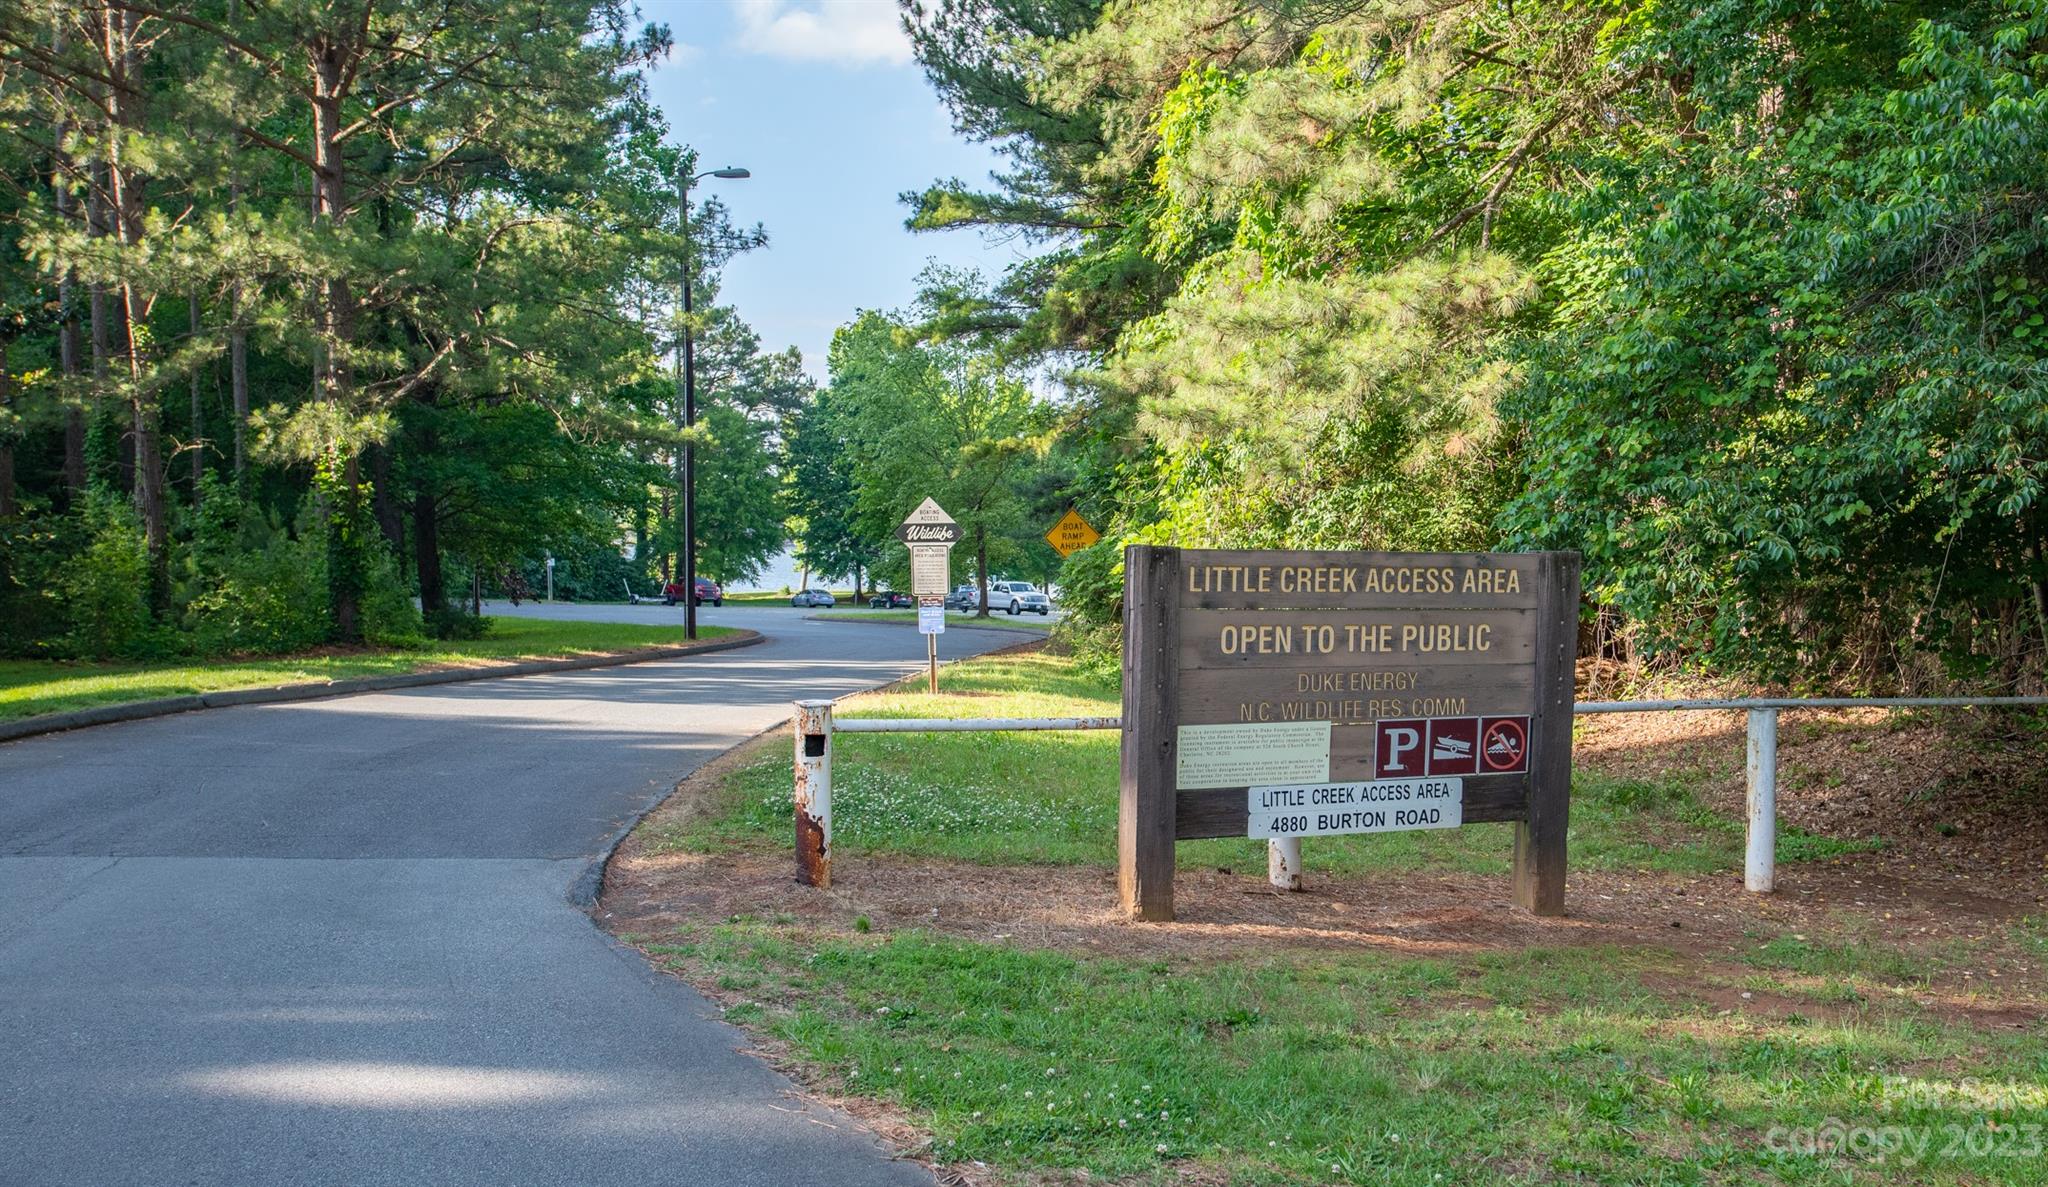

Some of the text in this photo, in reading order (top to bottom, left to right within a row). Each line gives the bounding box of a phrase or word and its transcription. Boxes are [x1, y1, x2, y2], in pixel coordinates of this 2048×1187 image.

[906, 525, 953, 540] Wildlife
[1189, 567, 1520, 593] LITTLE CREEK ACCESS AREA
[1220, 623, 1491, 654] OPEN TO THE PUBLIC
[1298, 672, 1418, 693] DUKE ENERGY
[1241, 698, 1465, 722] N.C. WILDLIFE RES. COMM
[1384, 728, 1419, 771] P
[1263, 782, 1450, 808] LITTLE CREEK ACCESS AREA
[1271, 808, 1441, 833] 4880 BURTON ROAD
